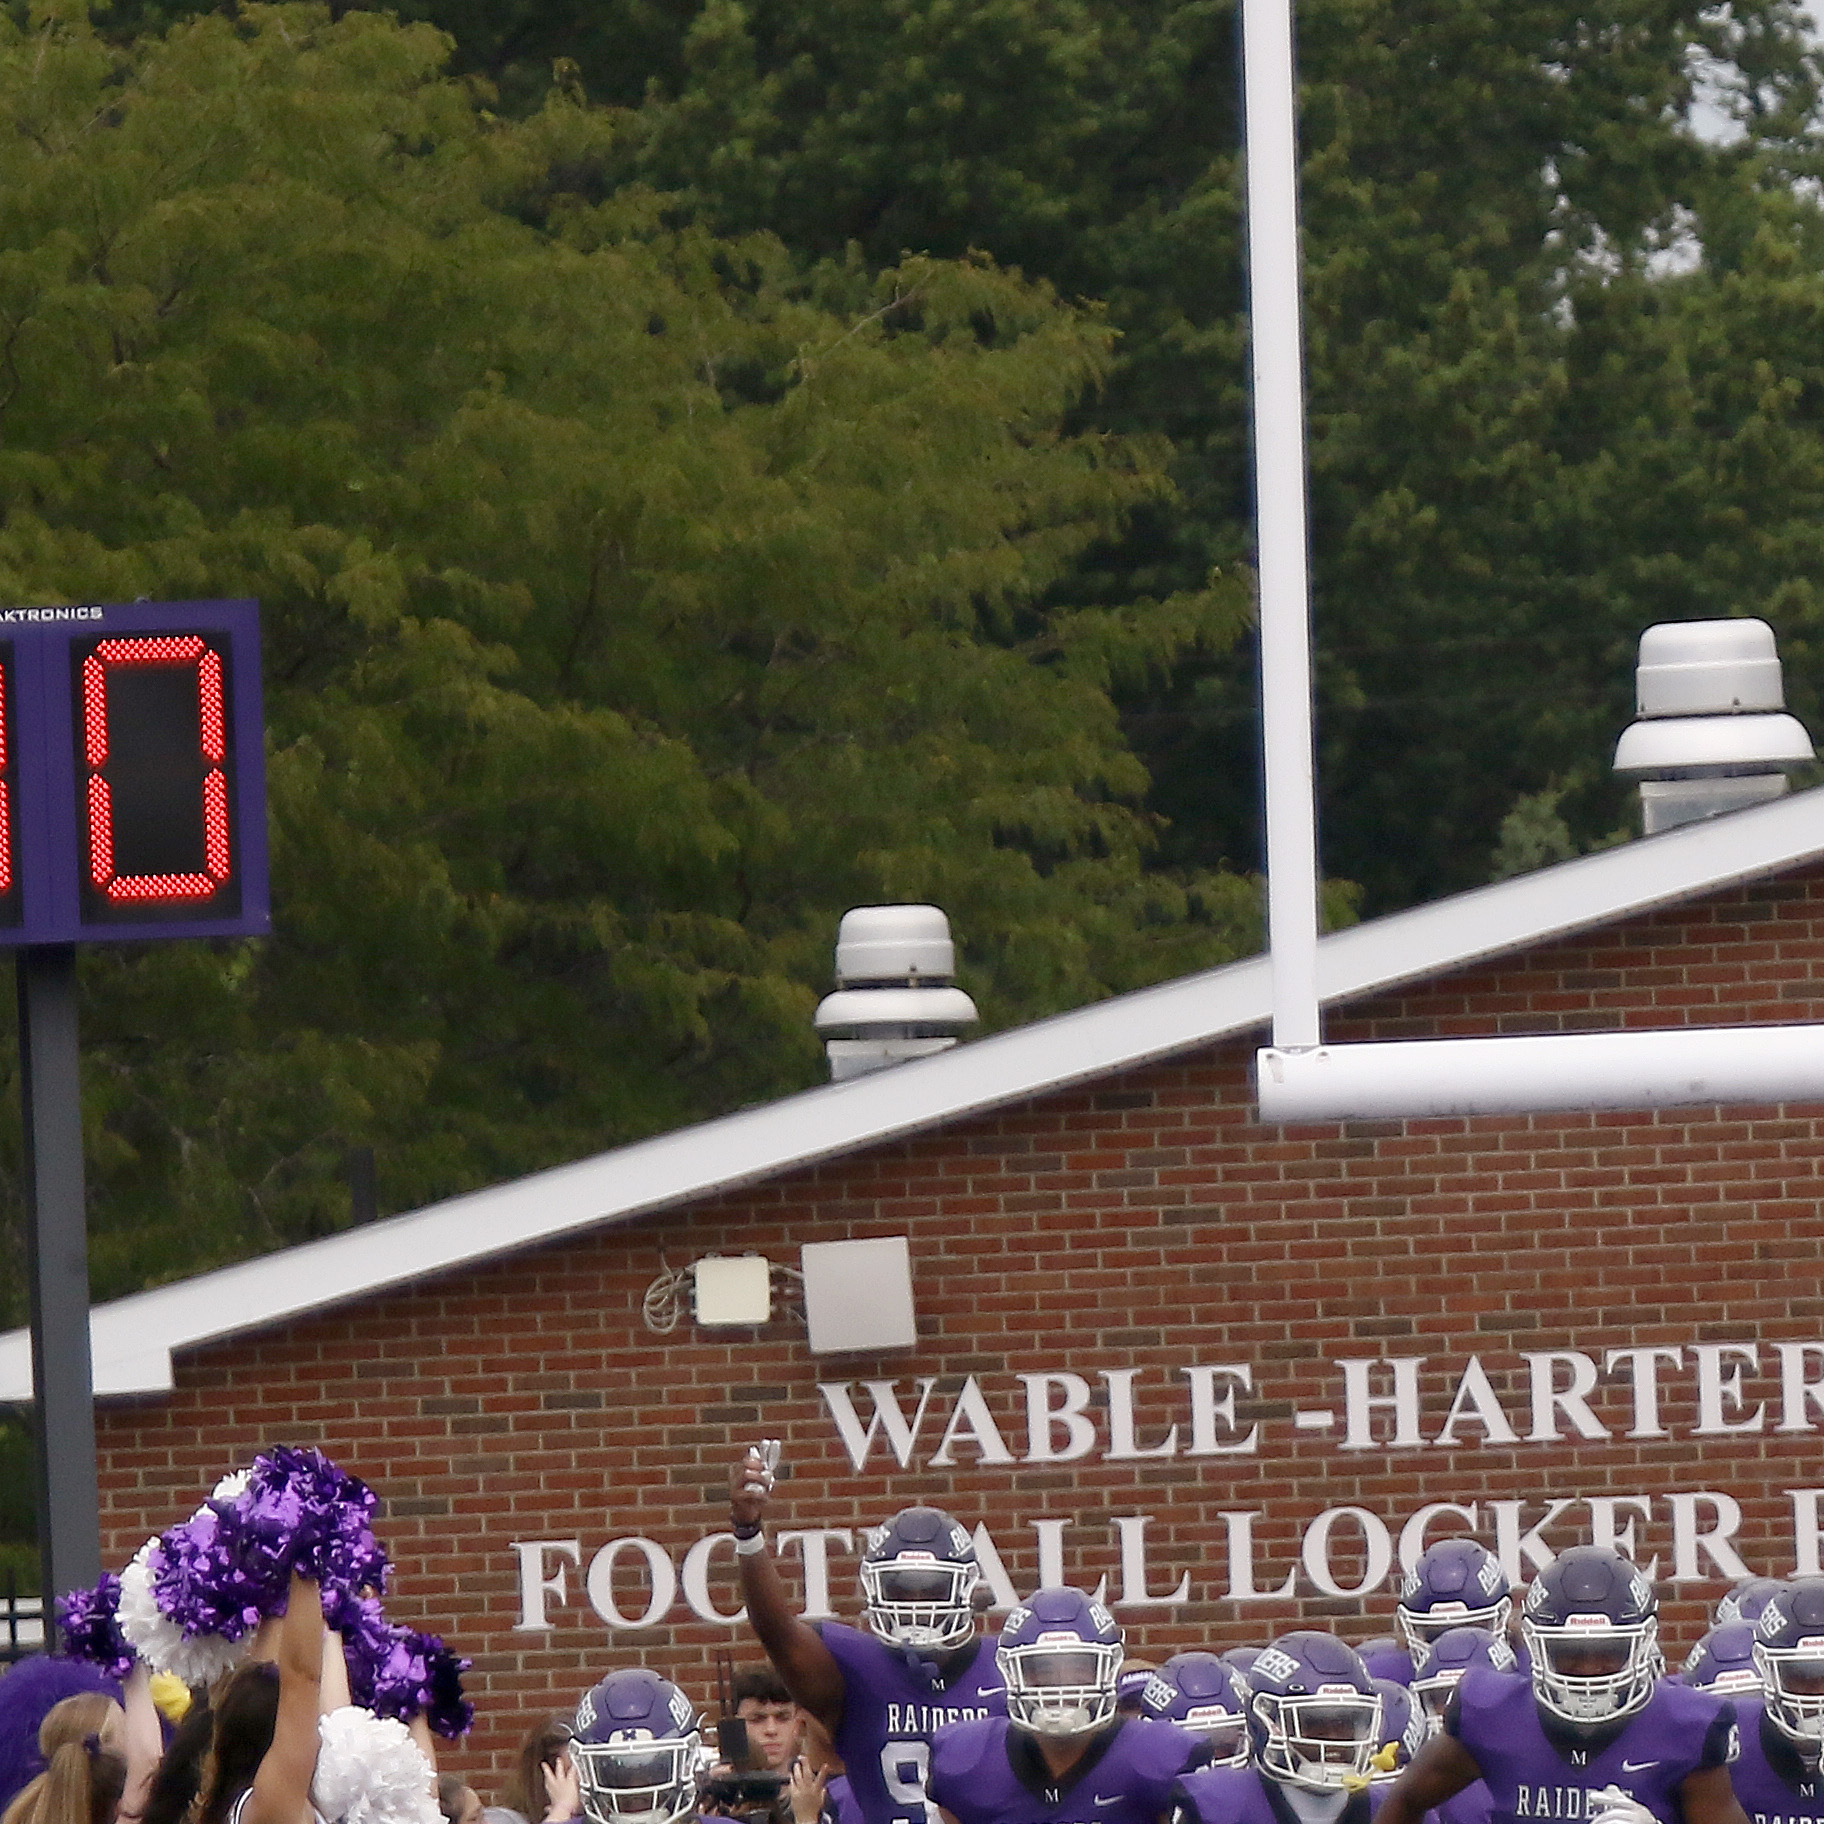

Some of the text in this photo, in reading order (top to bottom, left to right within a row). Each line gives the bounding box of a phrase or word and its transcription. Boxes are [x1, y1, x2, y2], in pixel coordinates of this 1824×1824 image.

[817, 1362, 1259, 1474] WABLE
[510, 1512, 1192, 1633] FOOTALL
[1571, 1750, 1587, 1767] M
[1516, 1784, 1635, 1819] RAIDE
[1800, 1784, 1815, 1798] M
